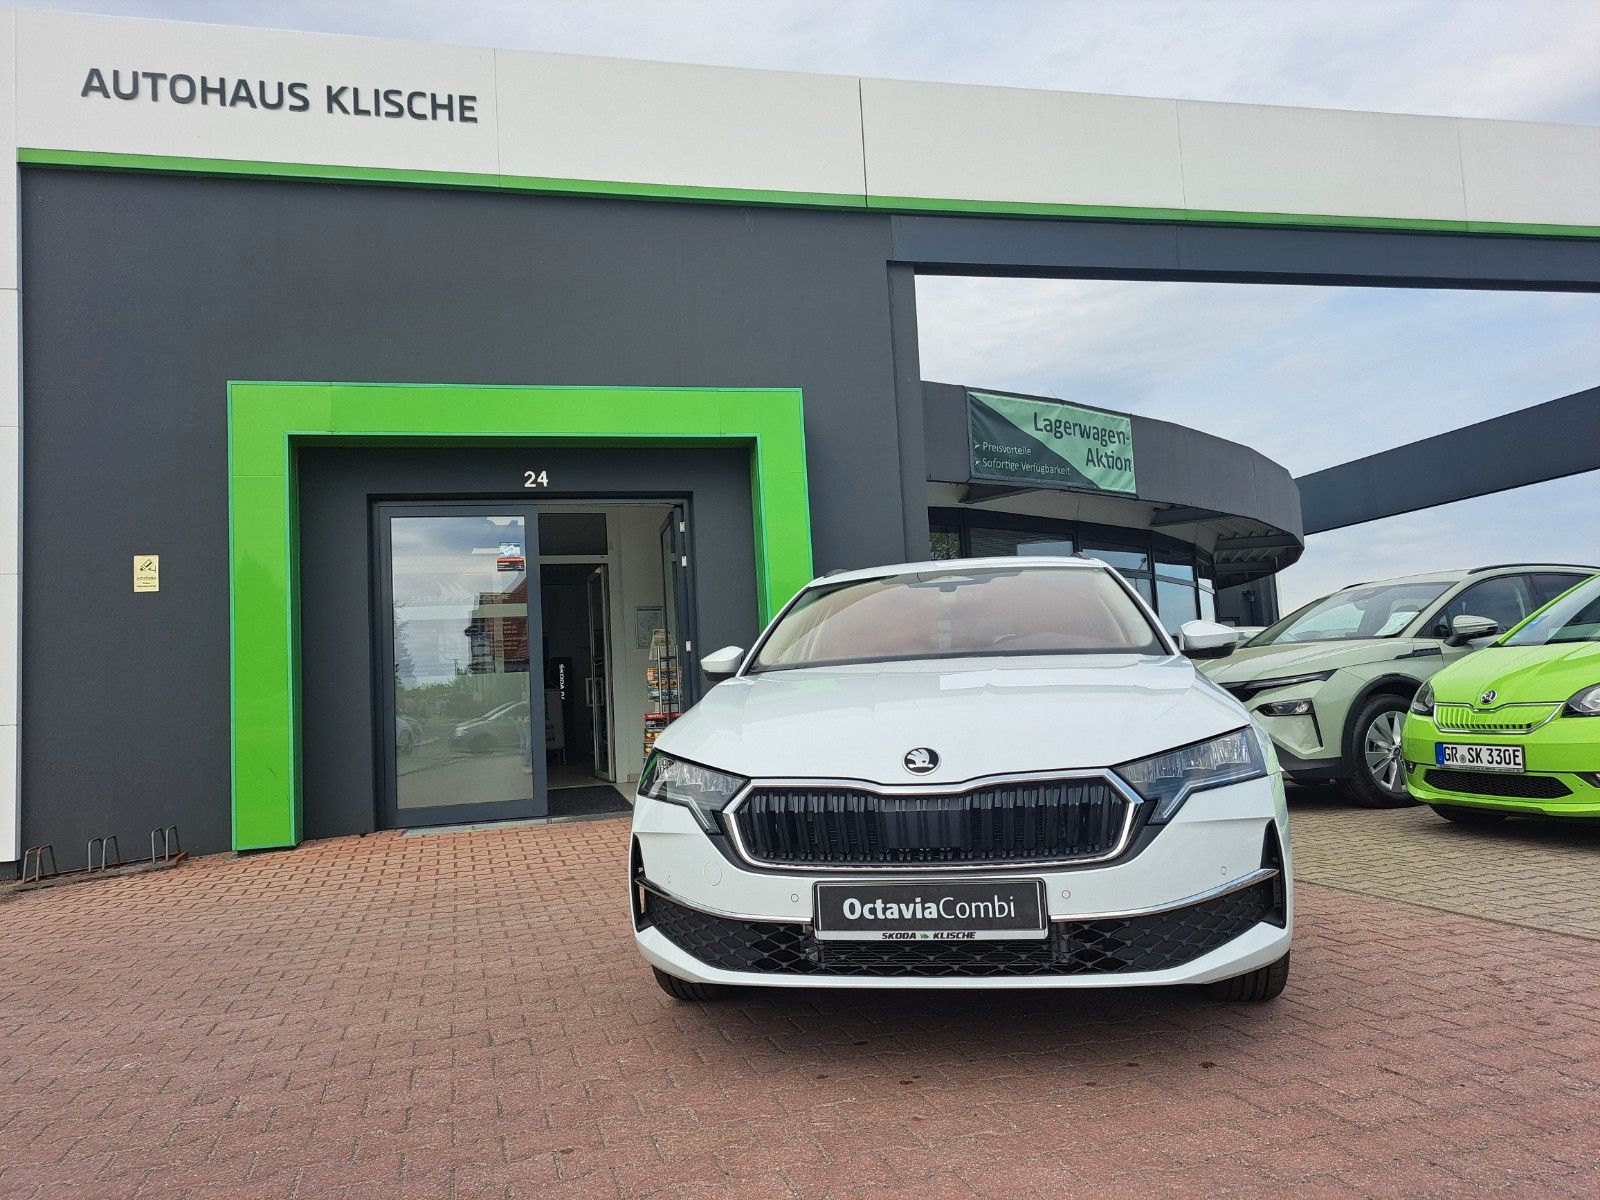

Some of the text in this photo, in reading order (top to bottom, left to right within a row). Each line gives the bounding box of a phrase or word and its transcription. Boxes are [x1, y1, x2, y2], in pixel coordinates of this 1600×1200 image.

[81, 67, 478, 123] AUTOHAUS KLISCHE
[1033, 411, 1130, 447] Lagerwagen-
[982, 441, 1032, 456] Preisvorteile
[982, 457, 1020, 471] Sofortige
[1086, 447, 1132, 472] Aktion
[524, 470, 548, 488] 24
[1444, 746, 1521, 766] GR SK 330E
[842, 894, 1015, 920] OctaviaCombi
[932, 931, 977, 940] KLISCHE
